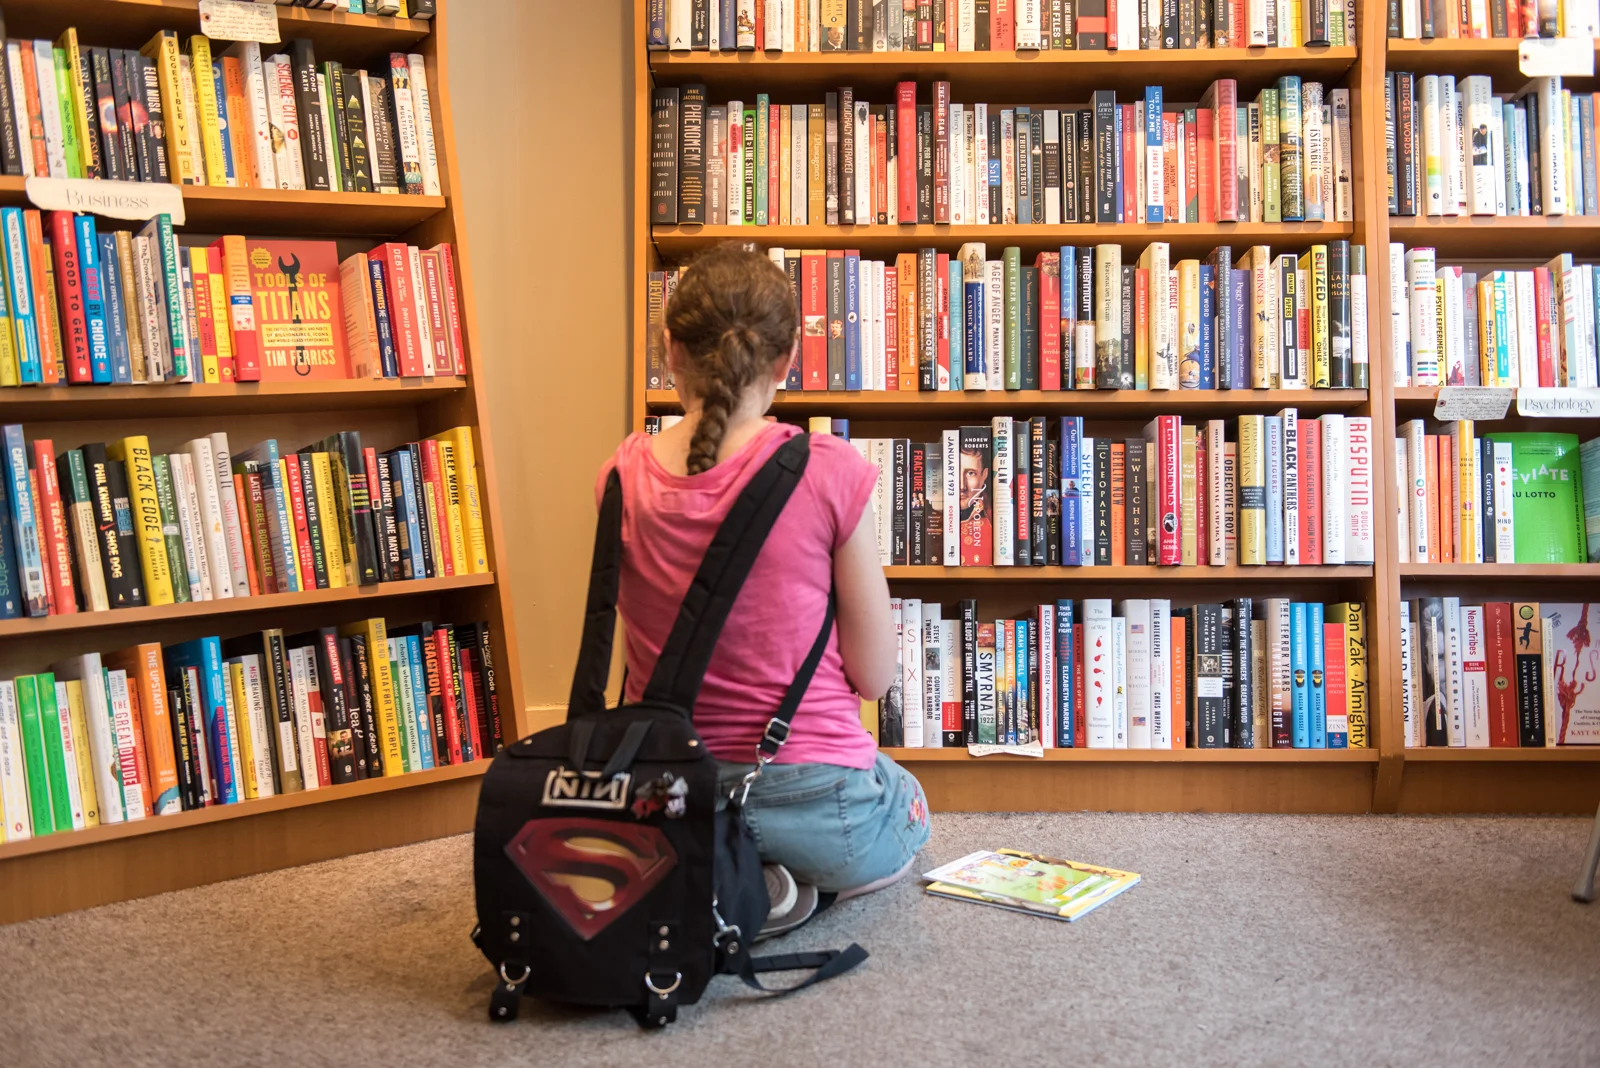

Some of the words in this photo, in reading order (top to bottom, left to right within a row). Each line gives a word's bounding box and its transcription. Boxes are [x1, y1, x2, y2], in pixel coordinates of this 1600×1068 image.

[144, 66, 157, 92] ELON
[168, 40, 184, 120] SUGGESTIBLE
[277, 63, 295, 100] SCIENCE
[301, 70, 310, 92] EARTH
[308, 64, 316, 93] BEYOND
[1402, 77, 1410, 112] BRIDGE
[146, 92, 160, 113] MUSK
[283, 102, 297, 126] CITY
[843, 90, 852, 135] DEMOCRACY
[684, 104, 701, 168] PHENOMENA
[1148, 120, 1154, 132] ME
[1403, 120, 1412, 155] WORDS
[843, 138, 852, 173] BETRAYED
[989, 161, 999, 183] Salt
[66, 188, 149, 209] Business
[64, 251, 76, 287] GOOD
[85, 268, 100, 300] GREAT
[254, 273, 305, 288] TOOLS
[309, 273, 327, 288] OF
[991, 264, 1000, 282] AGE
[1063, 254, 1073, 312] CASTLES
[1315, 252, 1326, 301] BLITZED
[69, 294, 79, 312] TO
[195, 280, 206, 319] BETTER
[991, 284, 1000, 293] OF
[88, 304, 101, 317] BY
[256, 291, 331, 321] TITANS
[991, 295, 1001, 324] ANGER
[72, 317, 85, 361] GREAT
[90, 319, 106, 359] CHOICE
[265, 350, 290, 366] TIM
[291, 349, 336, 366] FERRISS
[1524, 398, 1595, 413] Psychology
[1033, 422, 1043, 442] THE
[445, 447, 454, 474] DEEP
[1033, 444, 1043, 469] 15:17
[1286, 429, 1296, 470] BLACK
[1350, 423, 1368, 506] RASPUTIN
[94, 463, 105, 485] PHIL
[132, 447, 151, 491] BLACK
[378, 458, 389, 481] DARK
[913, 450, 923, 492] FRACTURE
[1034, 472, 1043, 485] TO
[1225, 459, 1234, 509] OBJECTIVE
[97, 485, 113, 522] KNIGHT
[302, 460, 313, 495] MICHAEL
[309, 496, 317, 521] LEWIS
[382, 481, 393, 508] MONEY
[449, 475, 460, 505] WORK
[1033, 487, 1043, 518] PARIS
[1099, 451, 1108, 537] CLEOPATRA
[1130, 465, 1142, 537] WITCHES
[1287, 473, 1297, 510] PANTHERS
[50, 501, 62, 538] TRACY
[141, 496, 160, 532] EDGE
[385, 515, 396, 536] JANE
[1225, 511, 1234, 535] TROY
[105, 530, 118, 554] SHOE
[389, 536, 399, 562] MAYER
[55, 541, 70, 587] KIDDER
[110, 555, 123, 578] DOG
[1348, 602, 1361, 635] Dan
[1468, 610, 1477, 656] NeuroTribes
[146, 650, 158, 669] THE
[425, 636, 440, 697] TRACTION
[1350, 638, 1363, 666] Zak
[149, 670, 164, 716] UPSTARTS
[980, 652, 993, 712] SMYRNA
[1450, 627, 1460, 730] SCIENCEBLIND
[1349, 678, 1365, 748] Almighty
